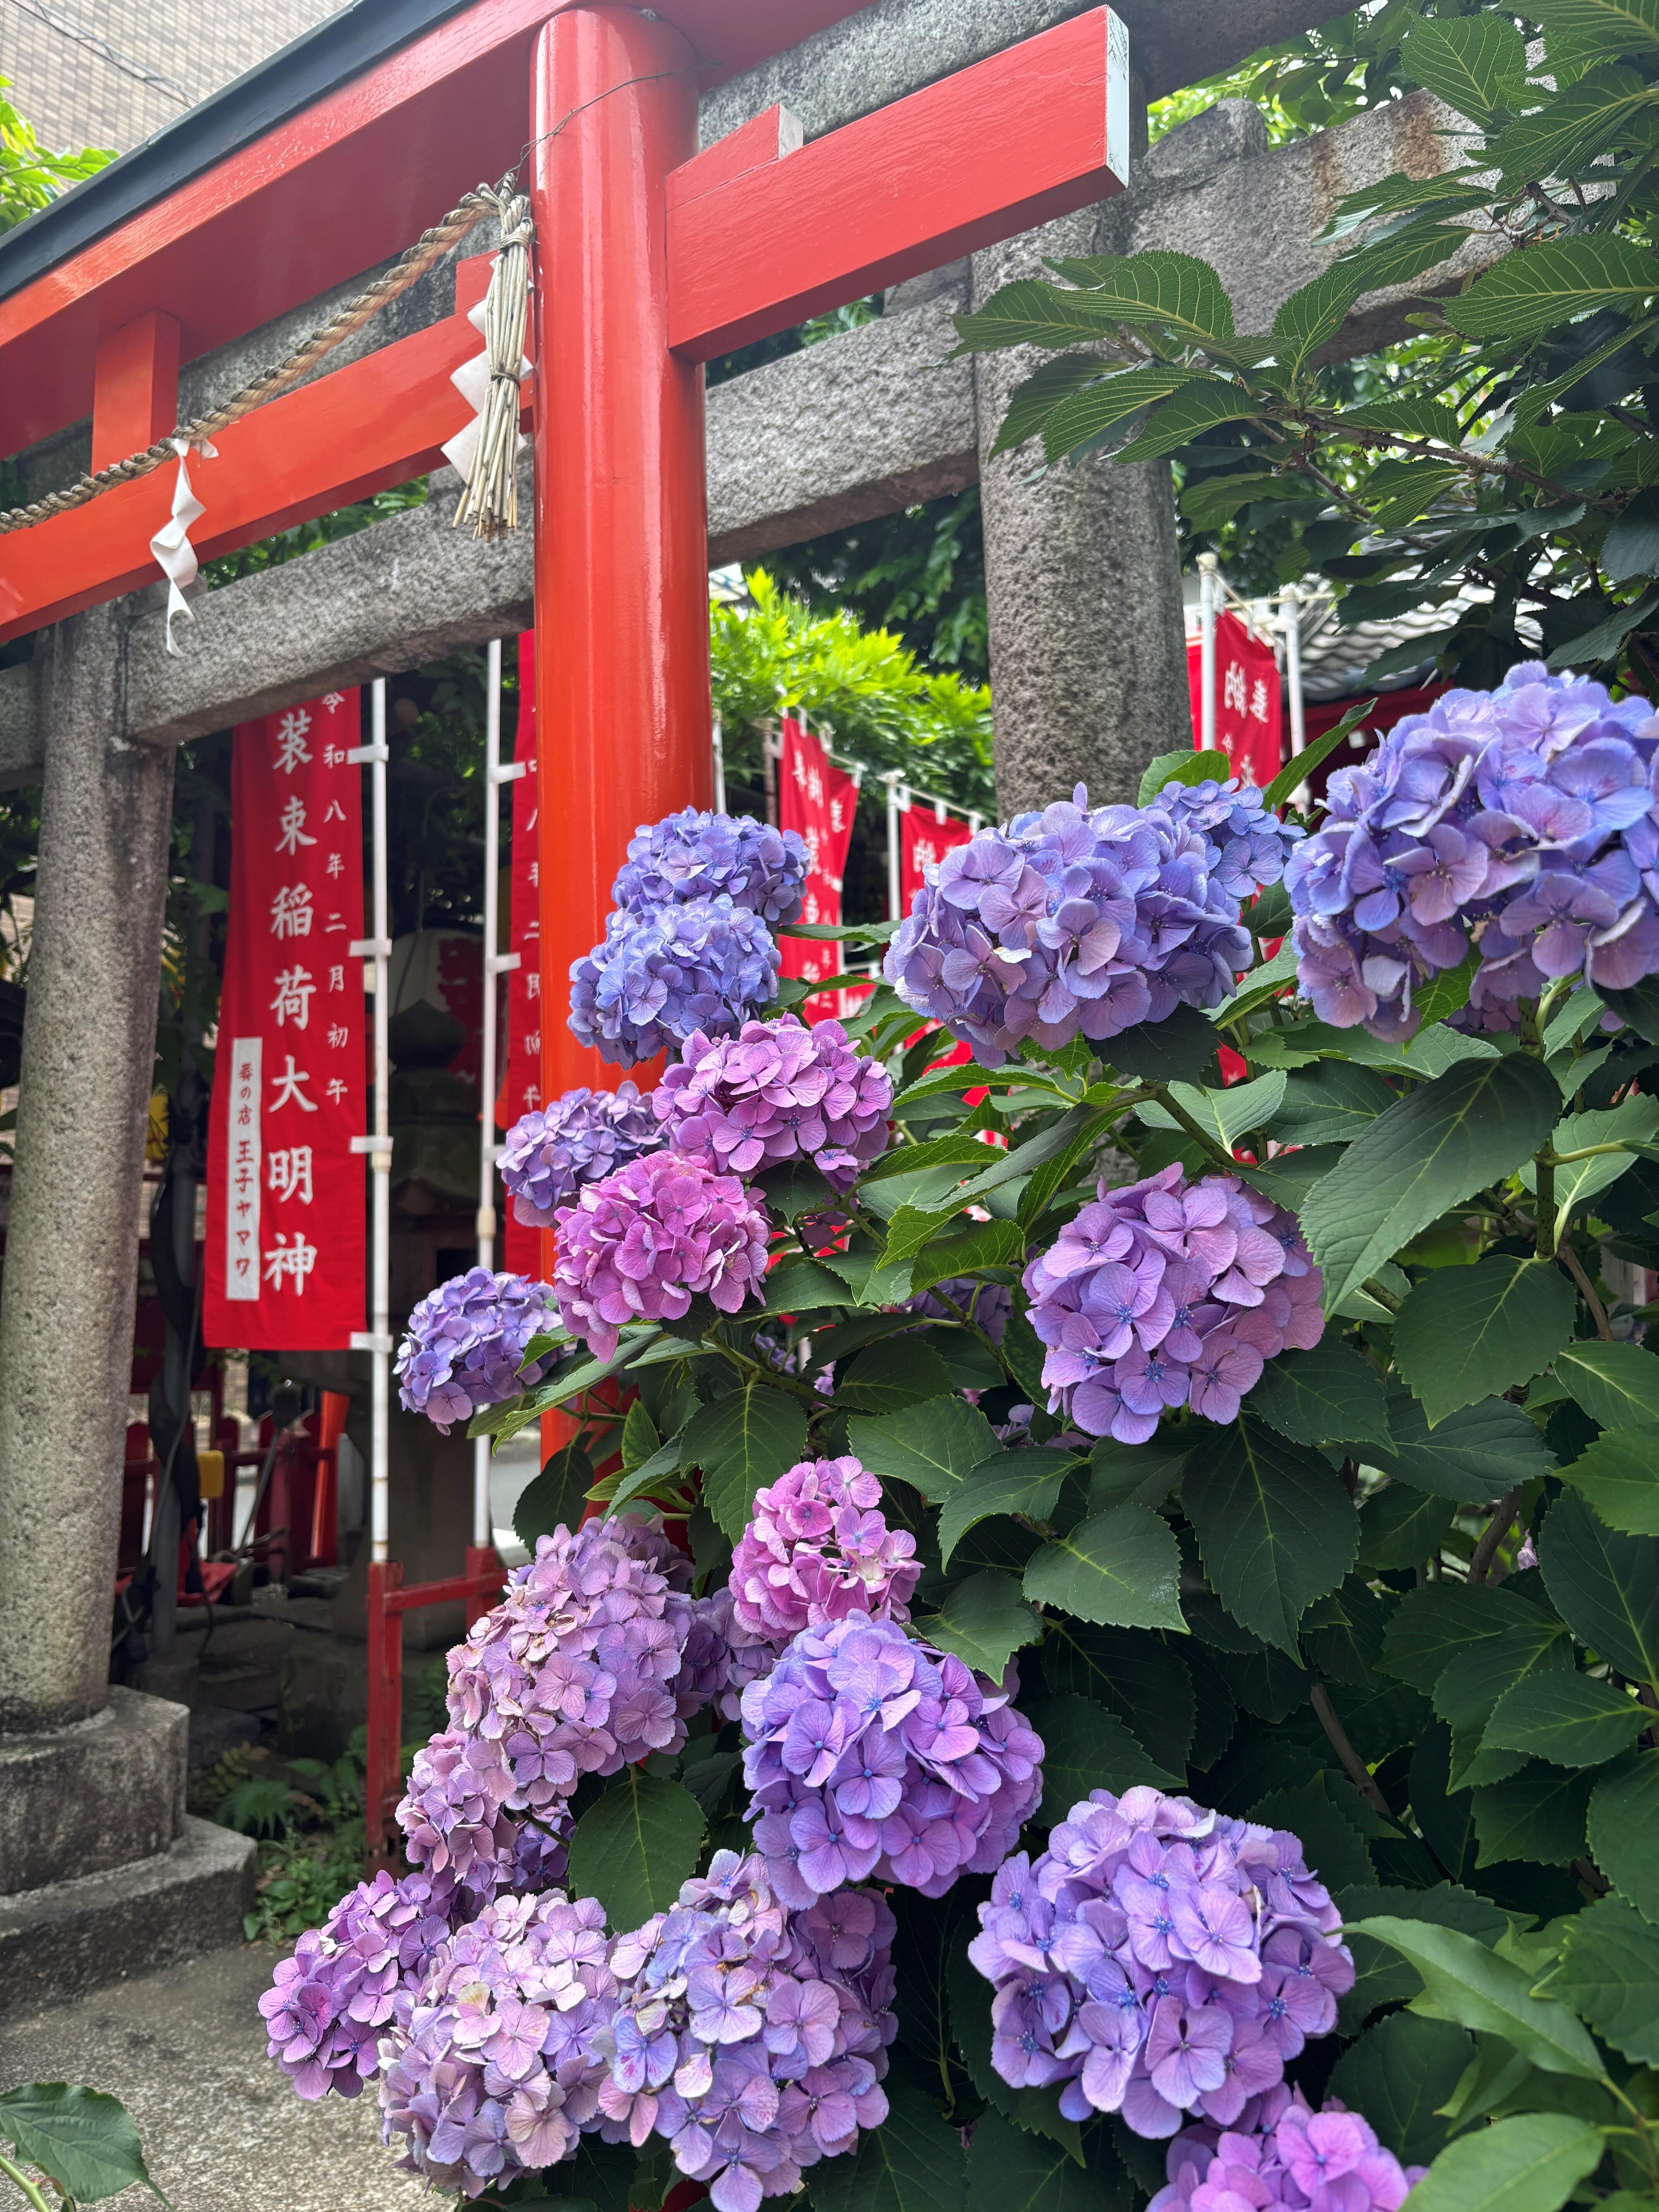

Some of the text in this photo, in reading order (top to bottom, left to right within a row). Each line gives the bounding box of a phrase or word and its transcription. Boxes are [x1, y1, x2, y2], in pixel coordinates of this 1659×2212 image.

[264, 708, 318, 1297] 装束稲荷大明神
[322, 692, 348, 1106] 令和八年二月初午
[235, 1140, 254, 1277] 王子ヤマワ
